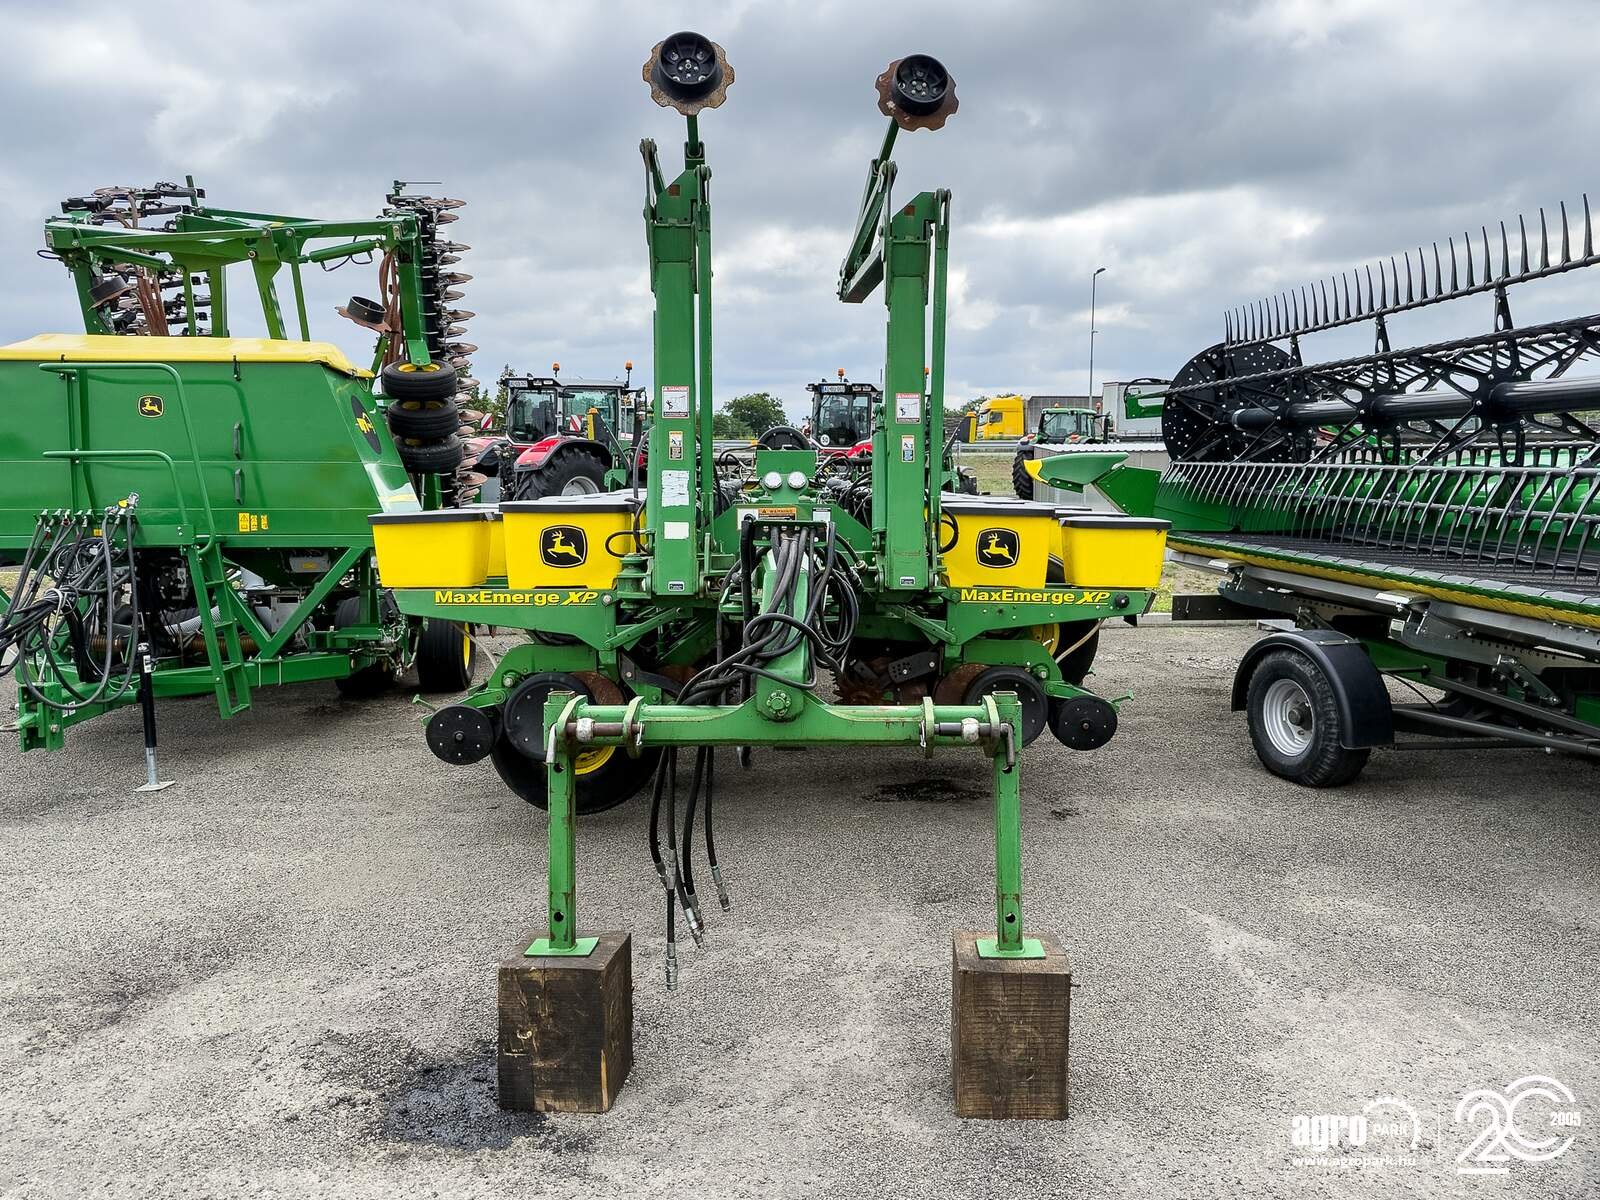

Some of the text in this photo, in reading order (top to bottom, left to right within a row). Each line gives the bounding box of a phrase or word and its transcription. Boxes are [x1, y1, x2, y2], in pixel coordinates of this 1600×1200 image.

[434, 591, 599, 606] MaxEmerge XP
[961, 589, 1111, 605] MaxEmerge XP
